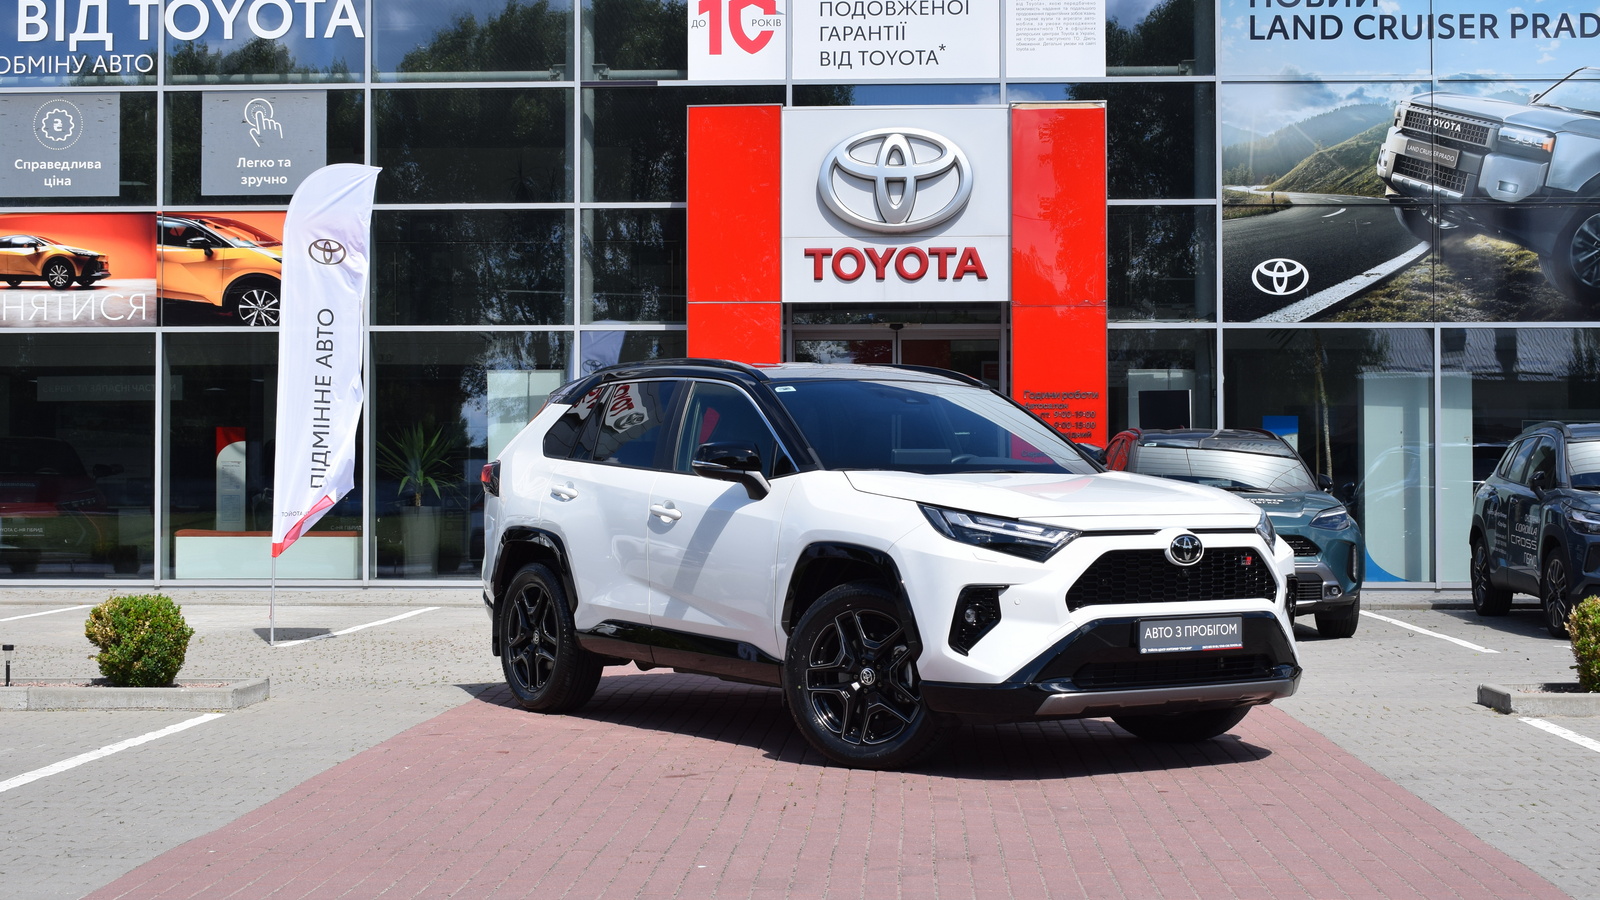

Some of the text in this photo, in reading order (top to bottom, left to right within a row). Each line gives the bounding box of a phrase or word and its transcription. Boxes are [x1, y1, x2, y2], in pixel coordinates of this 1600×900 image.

[16, 0, 365, 52] ВІД TOYOTA
[691, 19, 707, 29] ДО
[751, 18, 782, 27] РОКІВ
[1250, 14, 1344, 40] LAND
[1353, 13, 1499, 40] CRUISER
[819, 21, 907, 42] ГАРАНТІЇ
[0, 54, 154, 74] ОБМІНУ АВТО
[819, 51, 853, 69] ВІД
[1427, 117, 1461, 132] TOYOTA
[14, 159, 102, 172] Справедлива
[236, 157, 292, 170] Легко та
[43, 175, 72, 188] ціна
[240, 174, 288, 187] зручно
[804, 246, 989, 282] TOYOTA
[2, 293, 147, 321] НЯТИСЯ
[310, 308, 335, 489] ПІДМІННЕ АВТО
[1023, 390, 1099, 401] Години роботи
[1515, 523, 1538, 536] COROLLA
[1510, 534, 1537, 551] CROSS
[1144, 626, 1173, 639] АВТО
[1184, 623, 1238, 637] ПРОБІГОМ
